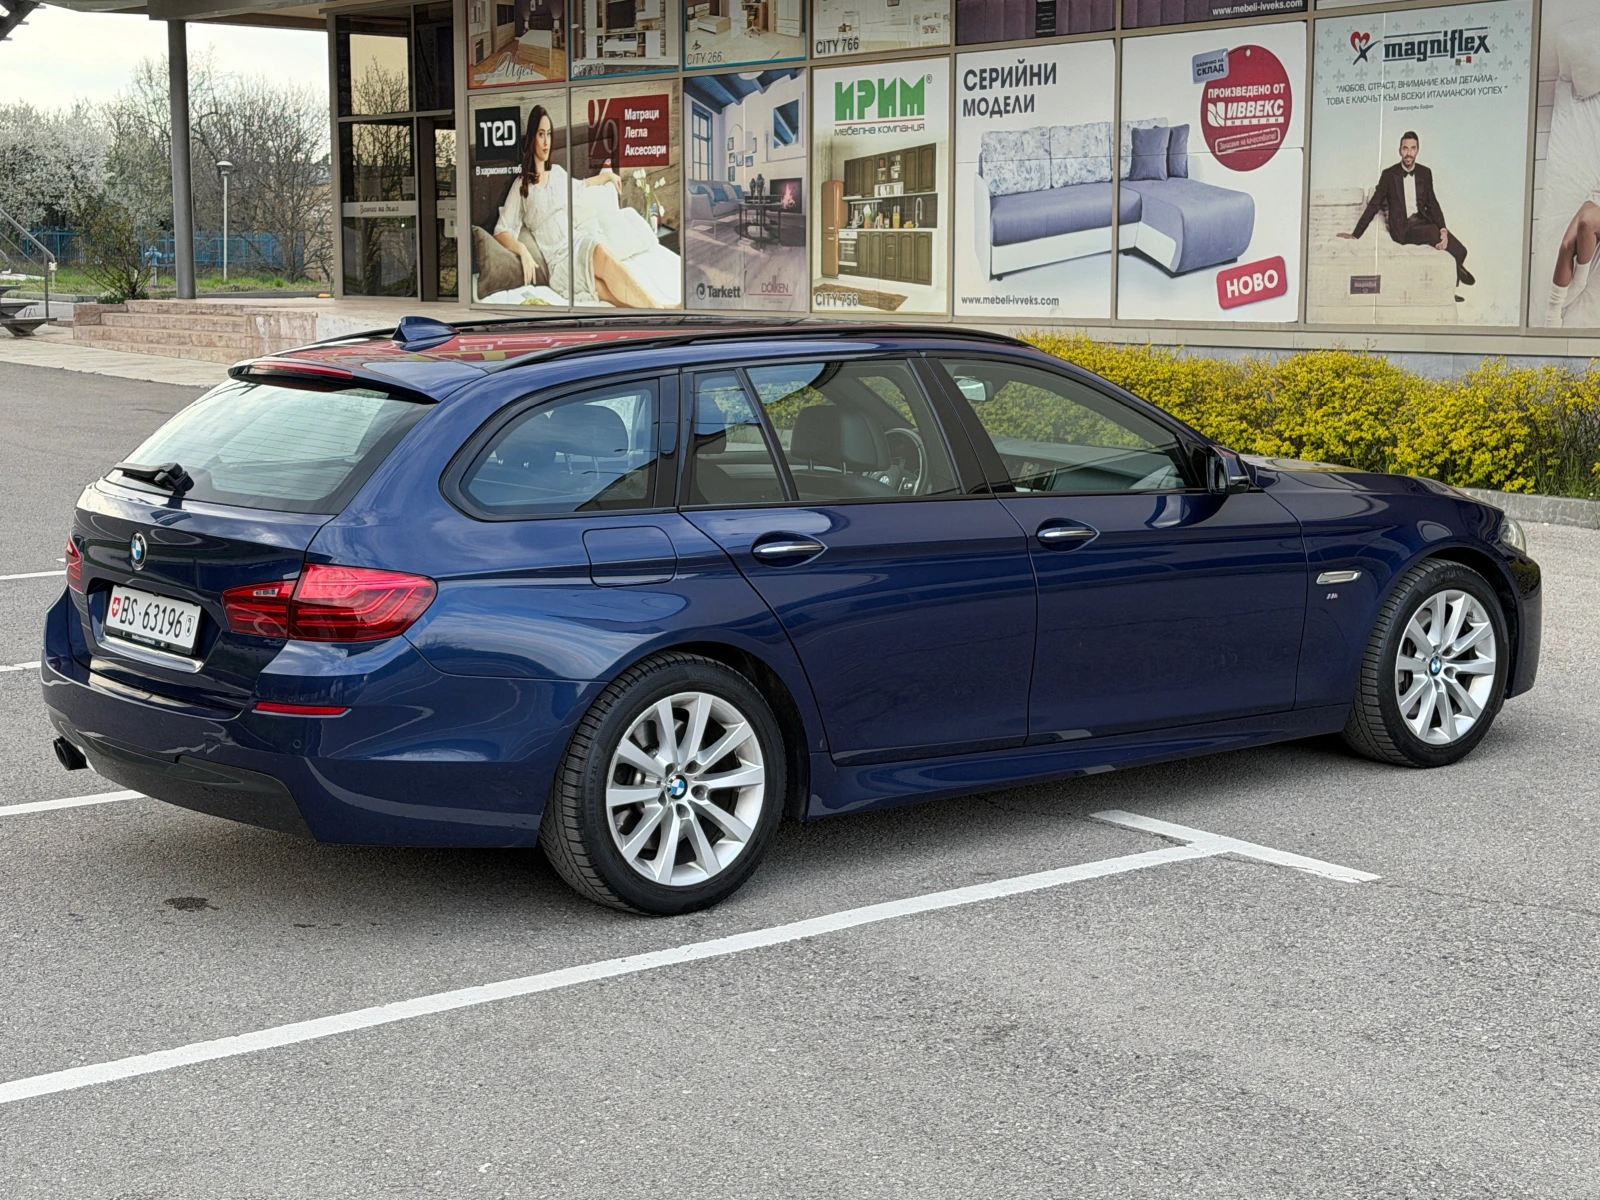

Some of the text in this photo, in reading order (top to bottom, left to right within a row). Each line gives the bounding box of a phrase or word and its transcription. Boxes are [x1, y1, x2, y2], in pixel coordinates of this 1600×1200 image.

[1212, 0, 1303, 16] www.mebeli-ivveks.com
[815, 37, 859, 54] CITY 766
[1384, 29, 1491, 62] magniflex
[686, 51, 723, 65] CITY 266
[963, 58, 1057, 92] СЕРИЙНИ
[1196, 63, 1225, 76] СКЛАД
[1398, 78, 1439, 89] ВНИМАНИЕ
[1440, 76, 1458, 86] КЪМ
[1459, 73, 1493, 85] ДЕТАЙЛА
[834, 74, 925, 122] ИРИМ
[1207, 83, 1286, 99] ПРОИЗВЕДЕНО ОТ
[1326, 97, 1344, 106] ТОВА
[1345, 96, 1351, 104] Е
[1351, 94, 1382, 104] КЛЮЧЪТ
[1383, 92, 1400, 102] КЪМ
[1401, 91, 1425, 100] ВСЕКИ
[1426, 88, 1476, 99] ИТАЛИАНСКИ
[1477, 86, 1503, 95] УСПЕХ
[963, 94, 1035, 119] МОДЕЛИ
[1226, 99, 1285, 119] ИВВЕКС
[624, 108, 660, 122] Матраци
[624, 126, 648, 138] Легла
[834, 123, 925, 136] мебелна компания
[624, 144, 667, 158] Аксесоари
[707, 285, 742, 298] Tarkett
[1226, 269, 1279, 299] НОВО
[815, 293, 858, 306] CITY 756
[960, 294, 1060, 306] www.mebeli-ivveks.com
[119, 596, 185, 639] BS 63196
